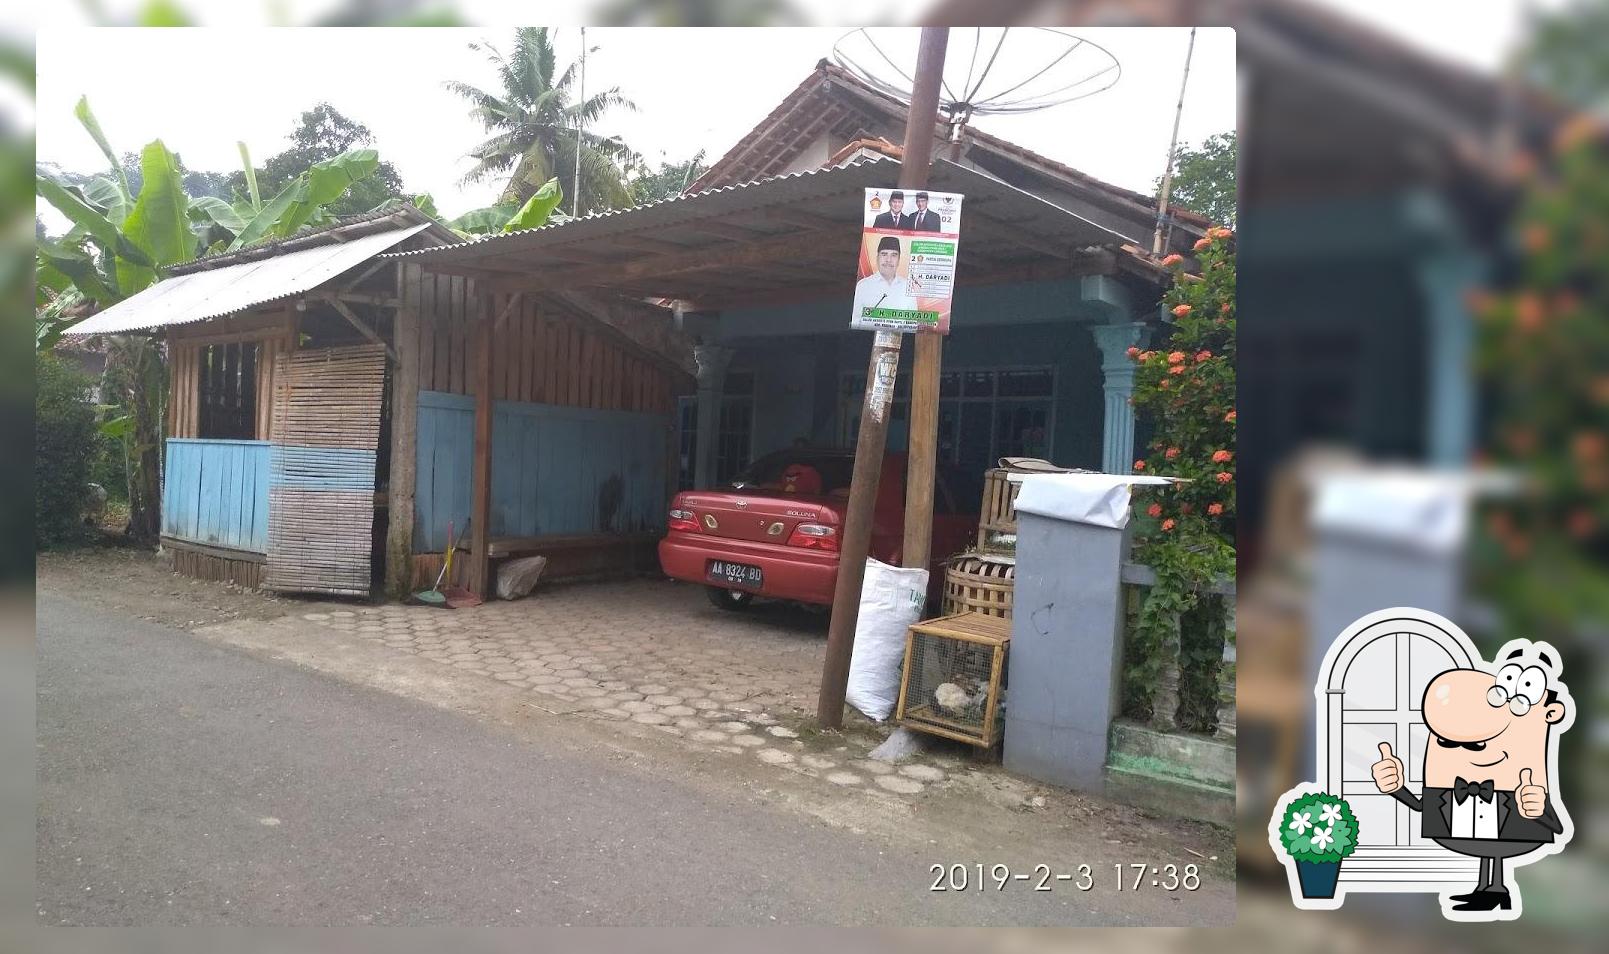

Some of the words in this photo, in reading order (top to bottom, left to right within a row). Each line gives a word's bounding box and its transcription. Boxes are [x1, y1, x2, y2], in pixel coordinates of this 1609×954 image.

[941, 215, 952, 223] 02
[864, 308, 872, 317] 3
[891, 311, 934, 320] DARYADI
[787, 510, 817, 518] SOLUNA
[712, 561, 723, 575] AA
[725, 563, 747, 579] 8324
[749, 567, 762, 582] BD
